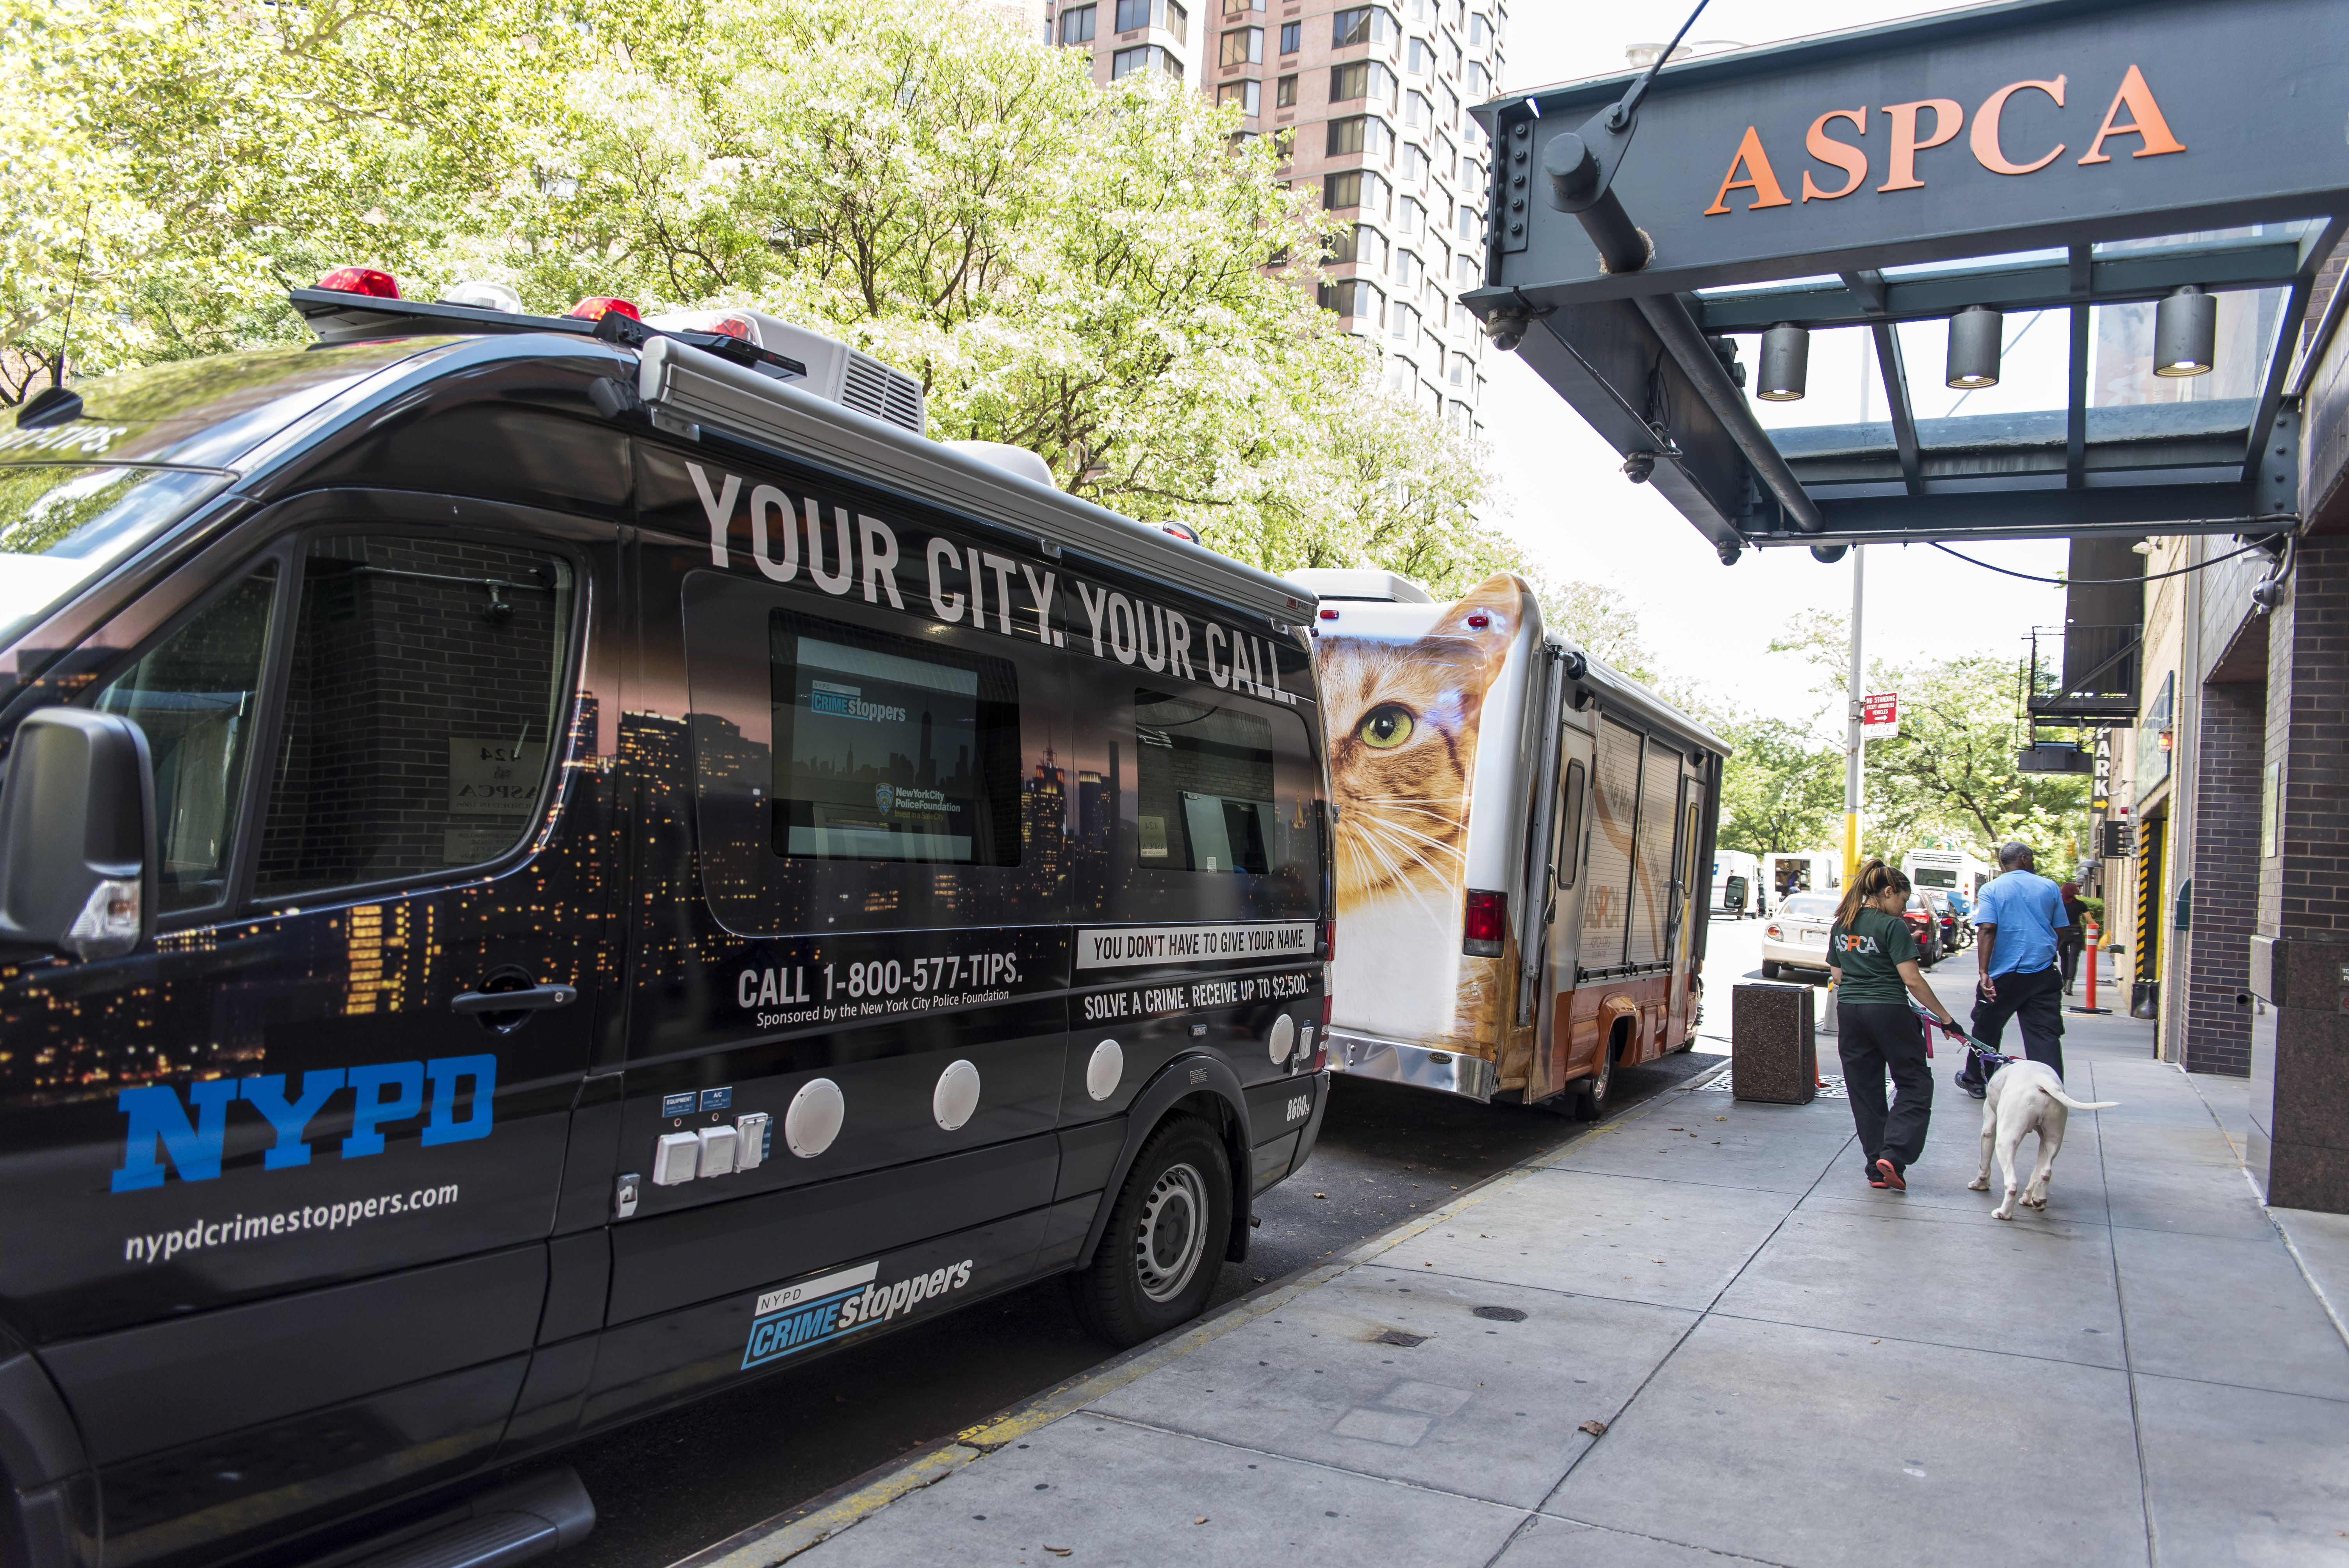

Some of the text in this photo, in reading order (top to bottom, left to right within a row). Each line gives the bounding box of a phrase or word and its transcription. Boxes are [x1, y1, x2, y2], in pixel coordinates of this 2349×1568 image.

[1704, 64, 2187, 216] ASPCA
[685, 461, 1297, 705] YOUR CITY. YOUR CALL.
[1874, 695, 1896, 703] STANDING
[2093, 727, 2112, 796] PARK
[895, 798, 961, 812] PoliceFoundation
[934, 813, 944, 822] City
[1583, 886, 1620, 929] ASPCA
[1094, 929, 1306, 960] YOU DON'T HAVE TO GIVE YOUR NAME.
[1835, 934, 1881, 953] ASPCA
[738, 952, 1023, 1009] CALL 1-800-577-TIPS.
[1084, 975, 1309, 1020] SOLVE A CRIME. RECEIVE UP TO $2,500.
[757, 989, 1009, 1028] Sponsored by the New York City Police Foundation
[667, 1096, 692, 1105] EQUIPMENT
[111, 1053, 497, 1194] NYPD
[125, 1183, 459, 1263] nypdcrimestoppers.com
[760, 1288, 802, 1311] NYPD
